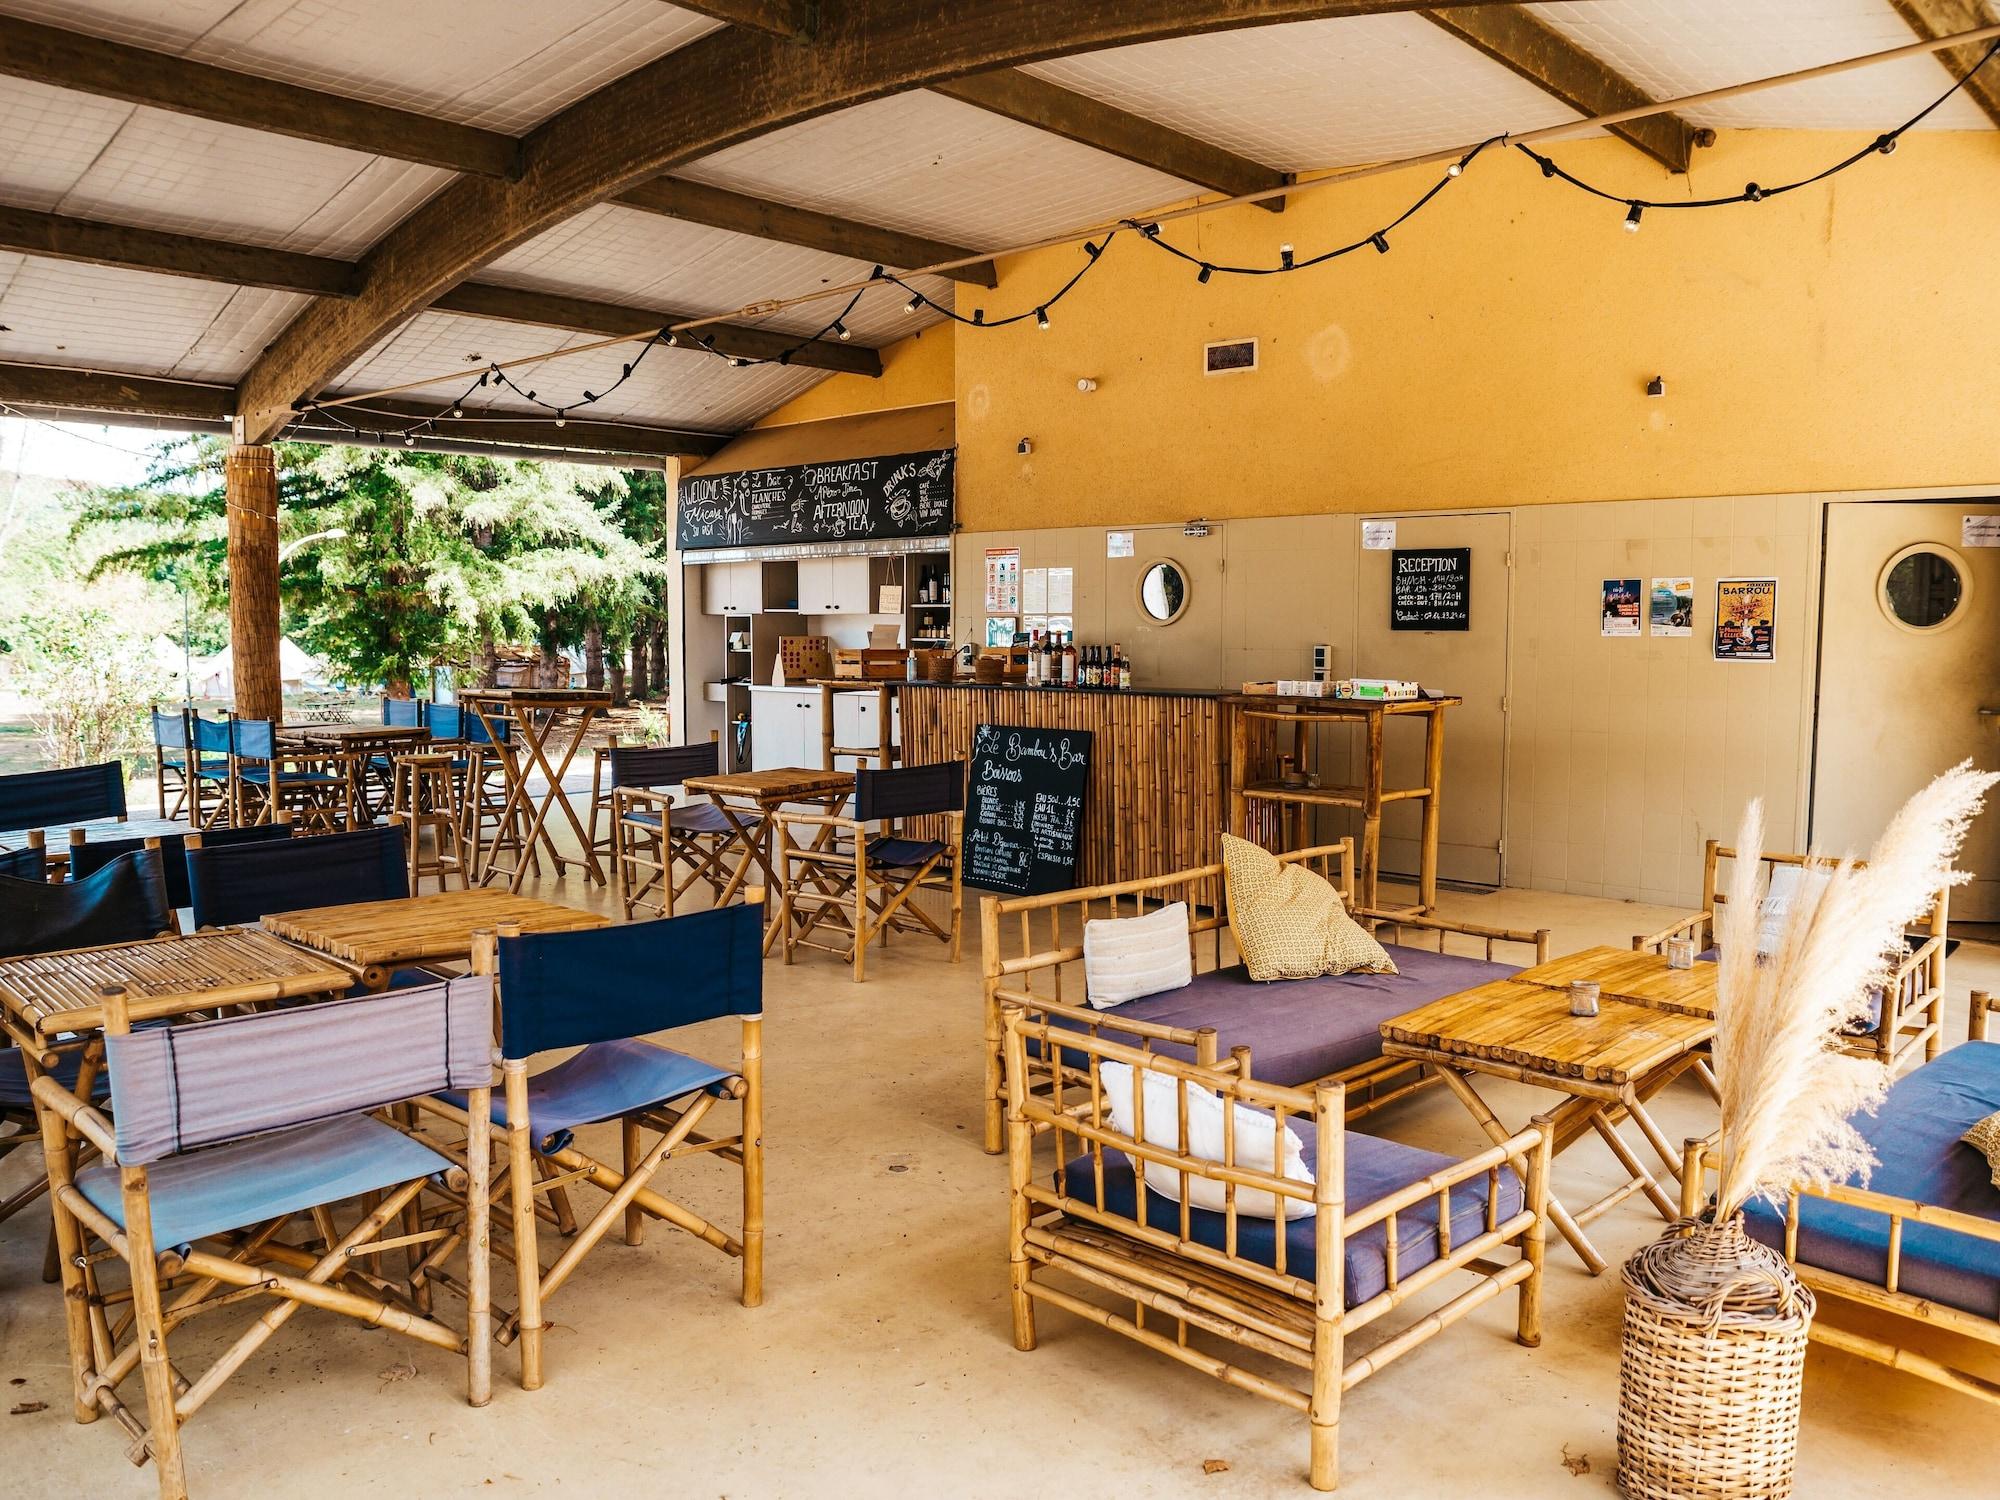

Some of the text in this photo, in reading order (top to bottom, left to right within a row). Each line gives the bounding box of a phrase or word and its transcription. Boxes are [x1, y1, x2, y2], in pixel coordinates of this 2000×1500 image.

[817, 462, 879, 484] BREAKFAST
[883, 462, 916, 497] DRINKS
[685, 479, 720, 505] WELCOME
[751, 491, 787, 503] PLANCHES
[813, 498, 870, 521] AFTERNOON
[846, 514, 869, 531] TEA
[1398, 558, 1458, 573] RECEPTION
[1395, 585, 1411, 595] BAR
[1723, 587, 1771, 595] BARROU
[981, 731, 1000, 755] Le
[1058, 738, 1087, 770] Bar
[1036, 793, 1047, 803] EAU
[1035, 803, 1046, 812] EAU
